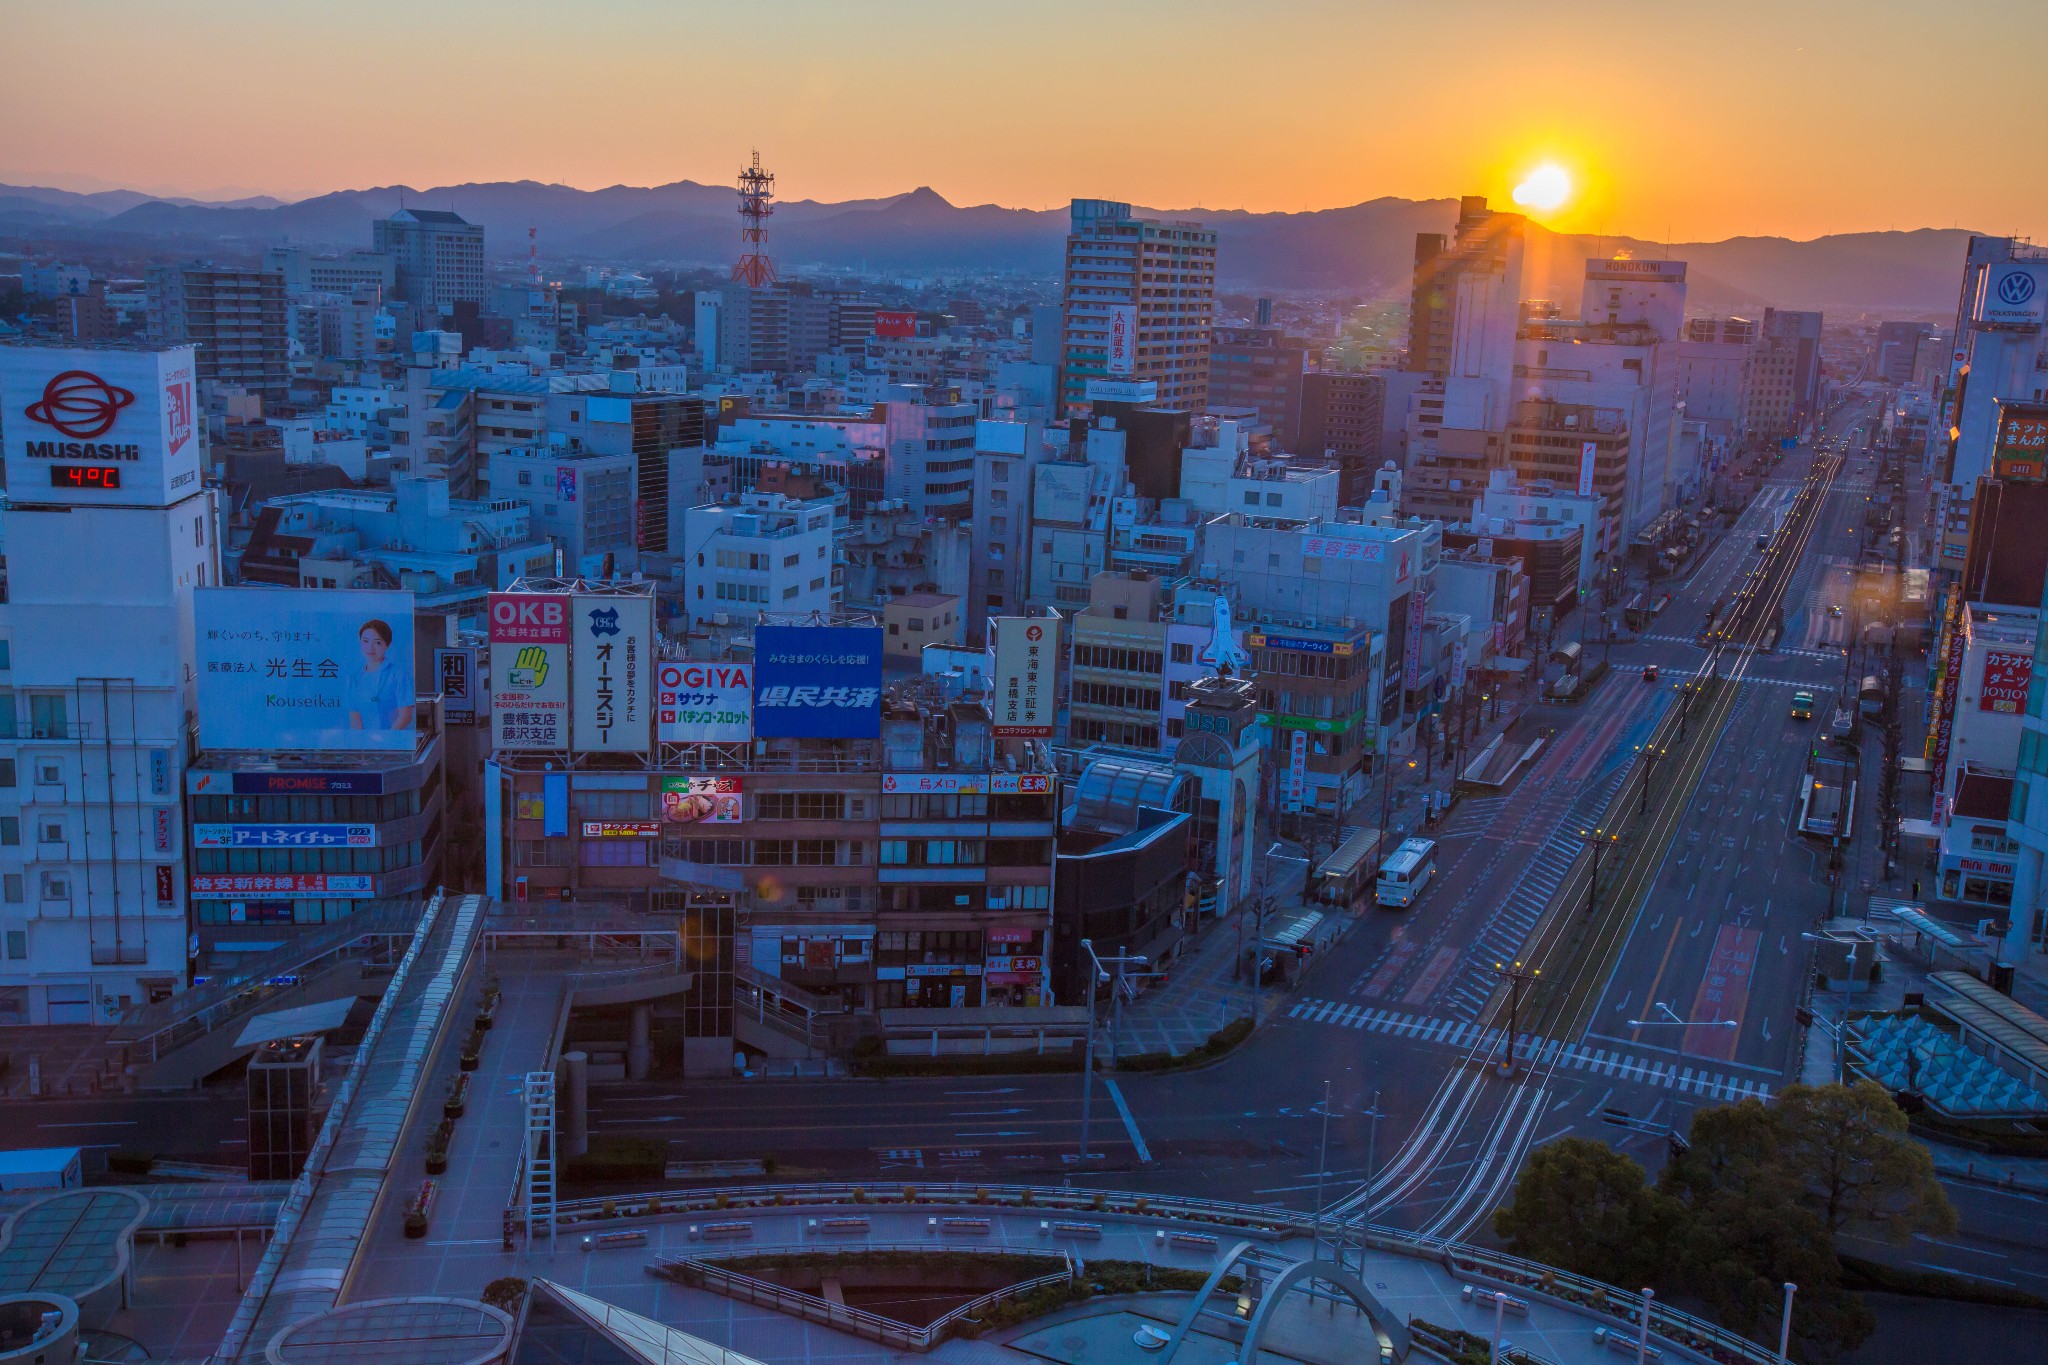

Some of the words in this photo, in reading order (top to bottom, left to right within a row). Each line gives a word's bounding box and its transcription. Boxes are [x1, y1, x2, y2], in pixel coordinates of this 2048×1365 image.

[1605, 261, 1661, 273] HONOKUNI
[1113, 310, 1125, 360] 大和証券
[721, 399, 734, 413] P
[2007, 420, 2047, 434] ネット
[2005, 433, 2046, 446] まんが
[1304, 538, 1382, 560] 美容学校
[493, 601, 564, 625] OKB
[207, 628, 321, 643] 輝くいのち、守ります。
[495, 627, 562, 638] 大垣共立銀行
[1949, 636, 1964, 675] カラオケ
[1987, 653, 2033, 669] カラオケ
[207, 661, 257, 674] 医療法人
[266, 657, 340, 680] 光生会
[443, 655, 465, 696] 和民
[2006, 666, 2014, 676] &
[625, 636, 637, 722] お客様の夢をカタチに
[660, 667, 749, 689] OGIYA
[1024, 645, 1040, 722] 東海東京証券
[1989, 673, 2029, 687] ダーツ
[266, 694, 341, 709] Kouseikai
[596, 643, 614, 744] オーエスジー
[663, 694, 674, 703] 2F
[677, 693, 719, 706] サウナ
[757, 686, 880, 708] 県民共済
[1006, 677, 1019, 722] 豊橋支店
[502, 712, 557, 726] 豊橋支店
[664, 713, 674, 721] 1F
[677, 710, 749, 724] パチンコ・スロット
[1186, 712, 1230, 735] USA
[502, 727, 557, 740] 藤沢支店
[1936, 718, 1952, 756] カラオケ
[268, 777, 327, 790] PROMISE
[330, 782, 352, 790] プロミス
[219, 836, 232, 845] 3F
[233, 829, 347, 845] アートネイチャー
[1960, 859, 1983, 871] mini
[1988, 862, 2012, 875] mini
[193, 877, 295, 891] 格安新幹線
